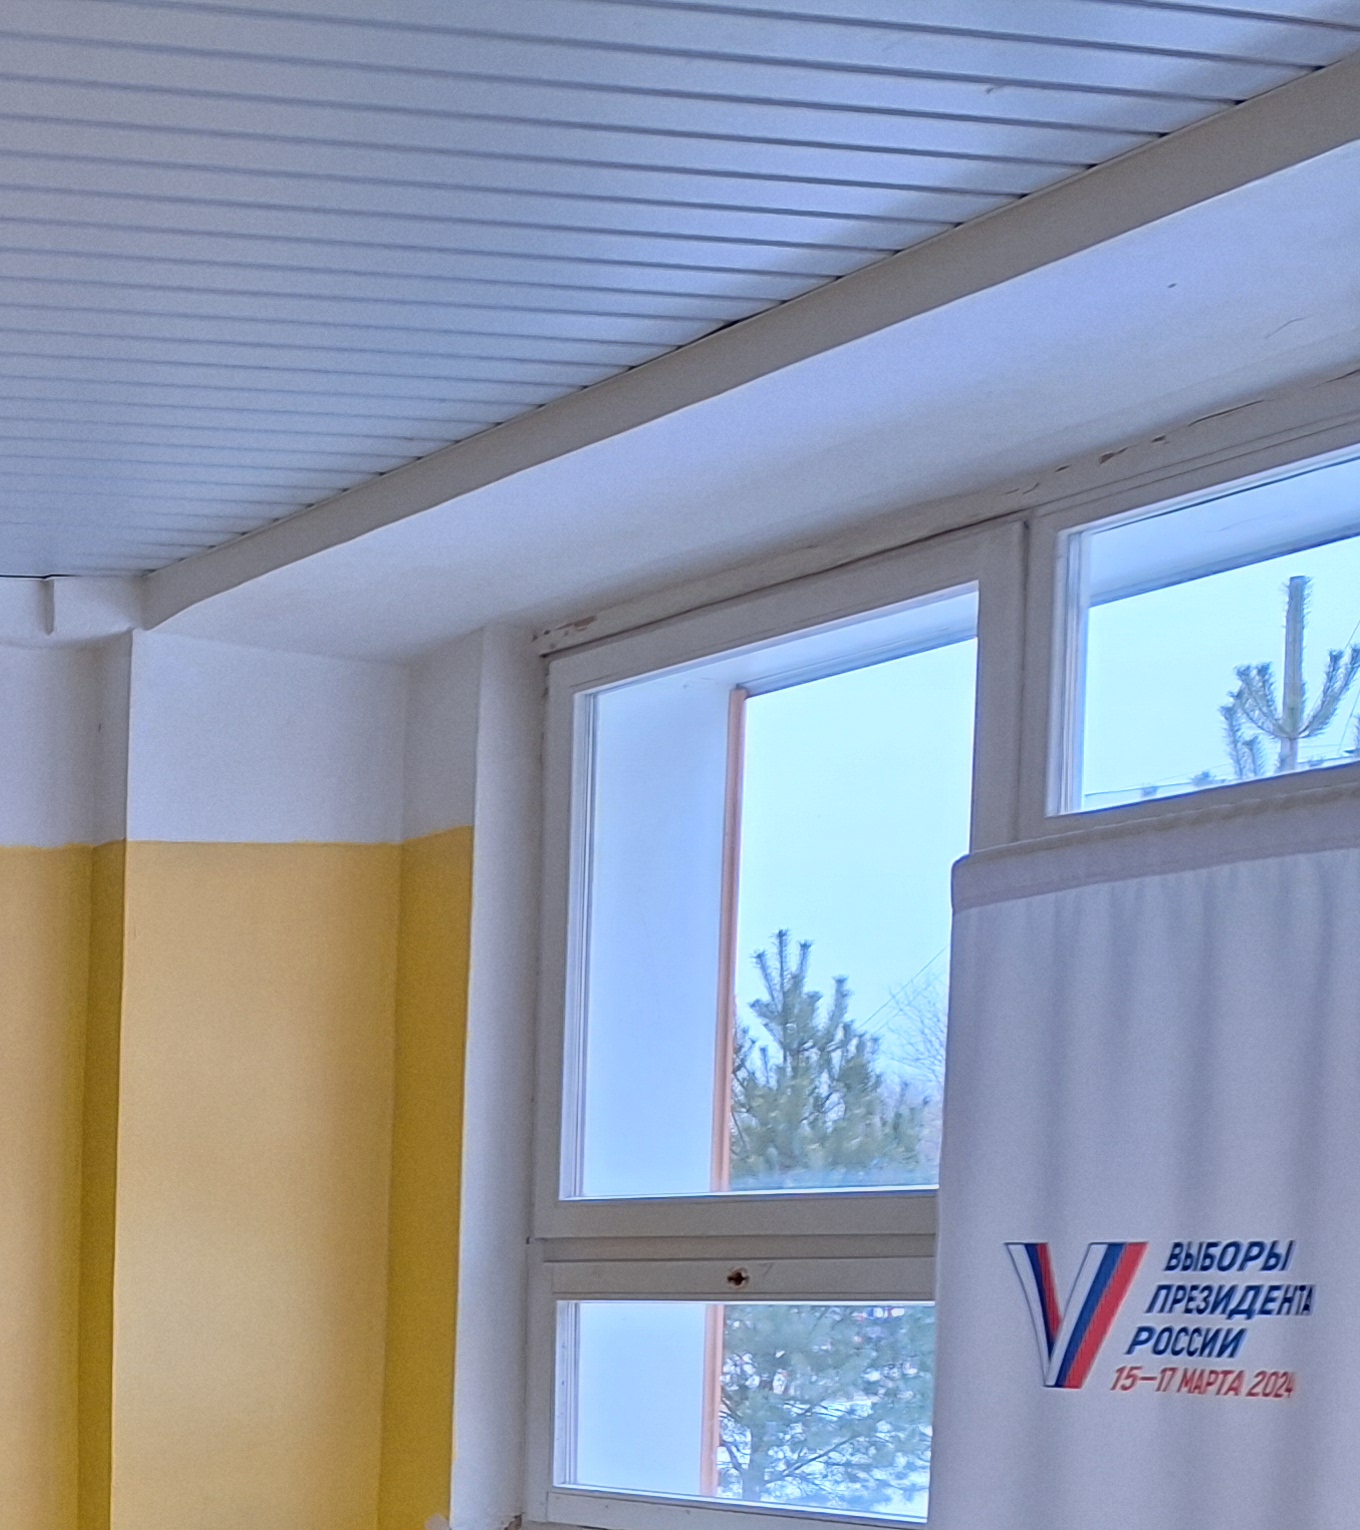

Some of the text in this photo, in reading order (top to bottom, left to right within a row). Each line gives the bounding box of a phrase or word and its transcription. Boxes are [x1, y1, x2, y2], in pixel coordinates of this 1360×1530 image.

[1163, 1239, 1296, 1272] ВЫБОРЫ
[1144, 1283, 1316, 1320] ПРЕЗИДЕНТА
[1123, 1325, 1248, 1359] РОССИИ
[1177, 1368, 1245, 1397] МАРТА
[1245, 1371, 1295, 1399] 2024
